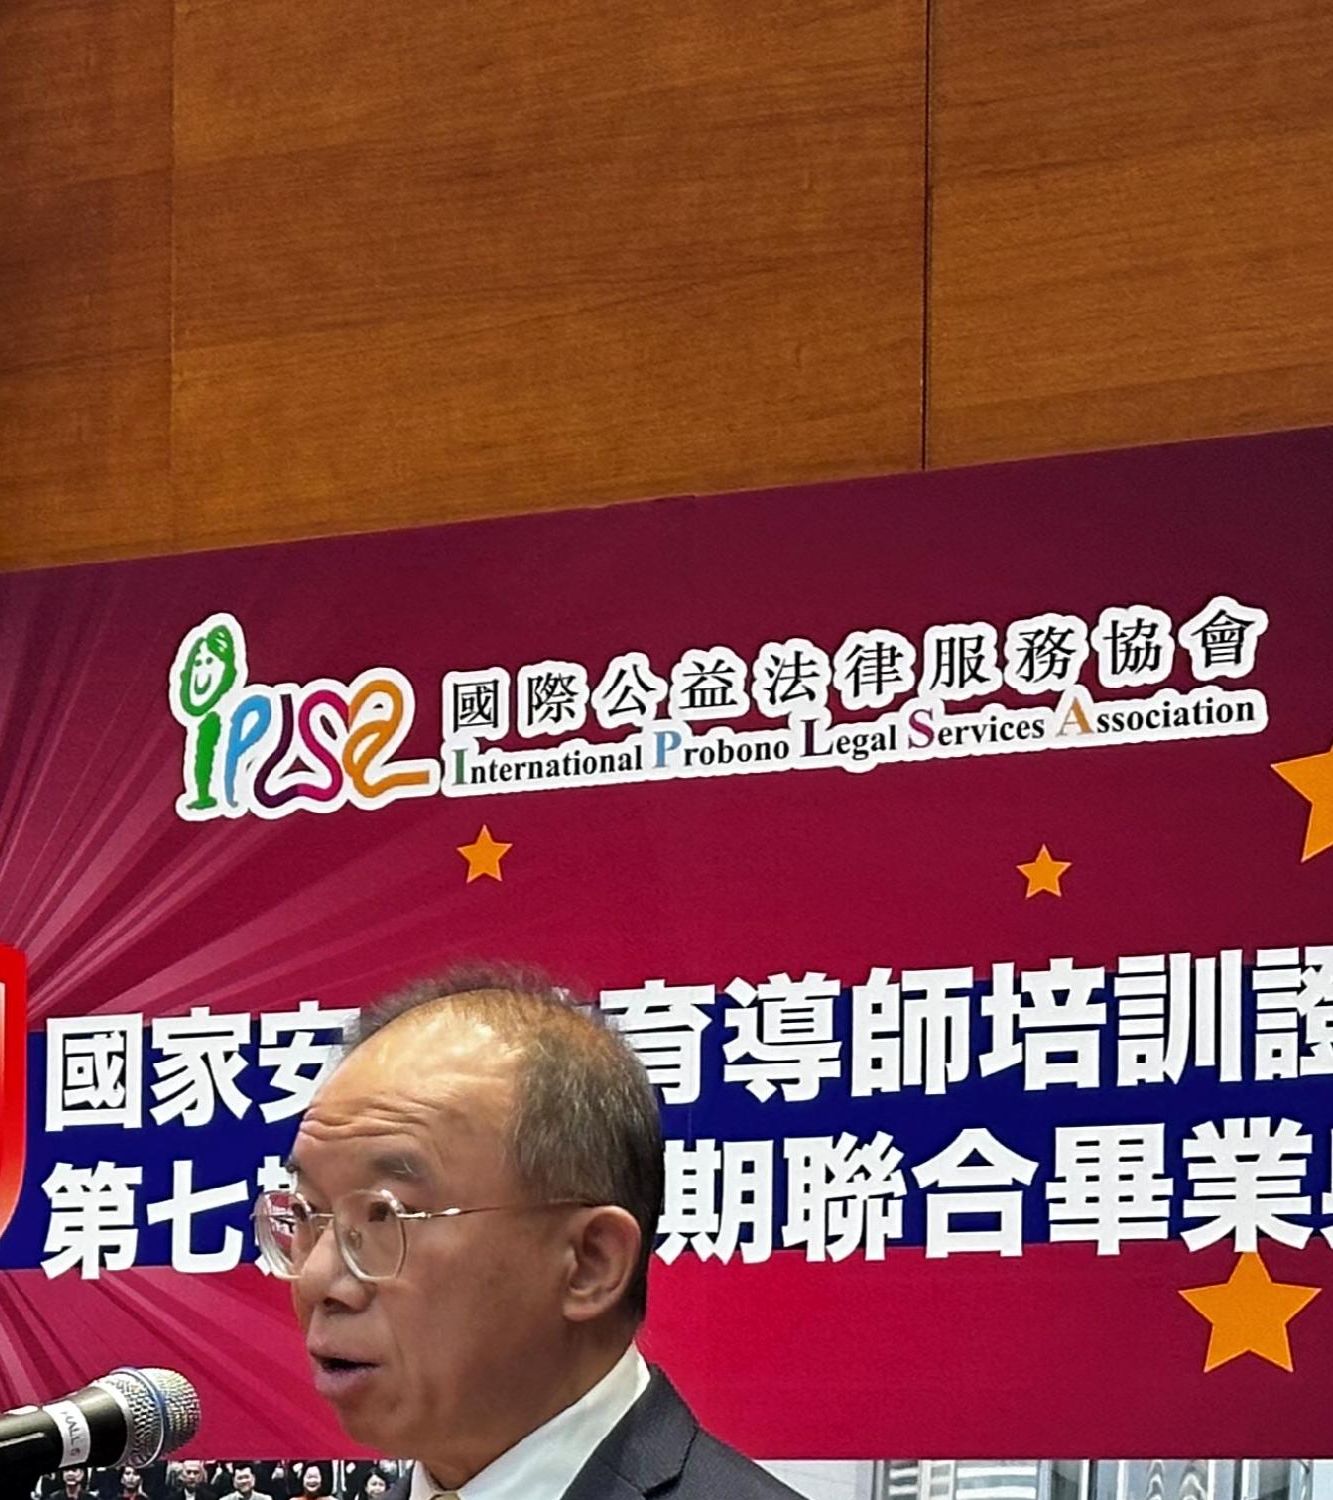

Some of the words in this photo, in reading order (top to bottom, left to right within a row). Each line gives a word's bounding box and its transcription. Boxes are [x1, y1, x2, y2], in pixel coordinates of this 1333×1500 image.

[452, 609, 1255, 734] 國際公益法律服務協會
[451, 745, 642, 786] International
[654, 730, 789, 769] Probono
[800, 718, 897, 761] Legal
[907, 708, 1045, 750] Services
[1055, 697, 1255, 737] Association
[44, 945, 1333, 1132] 國家安育導師培訓證
